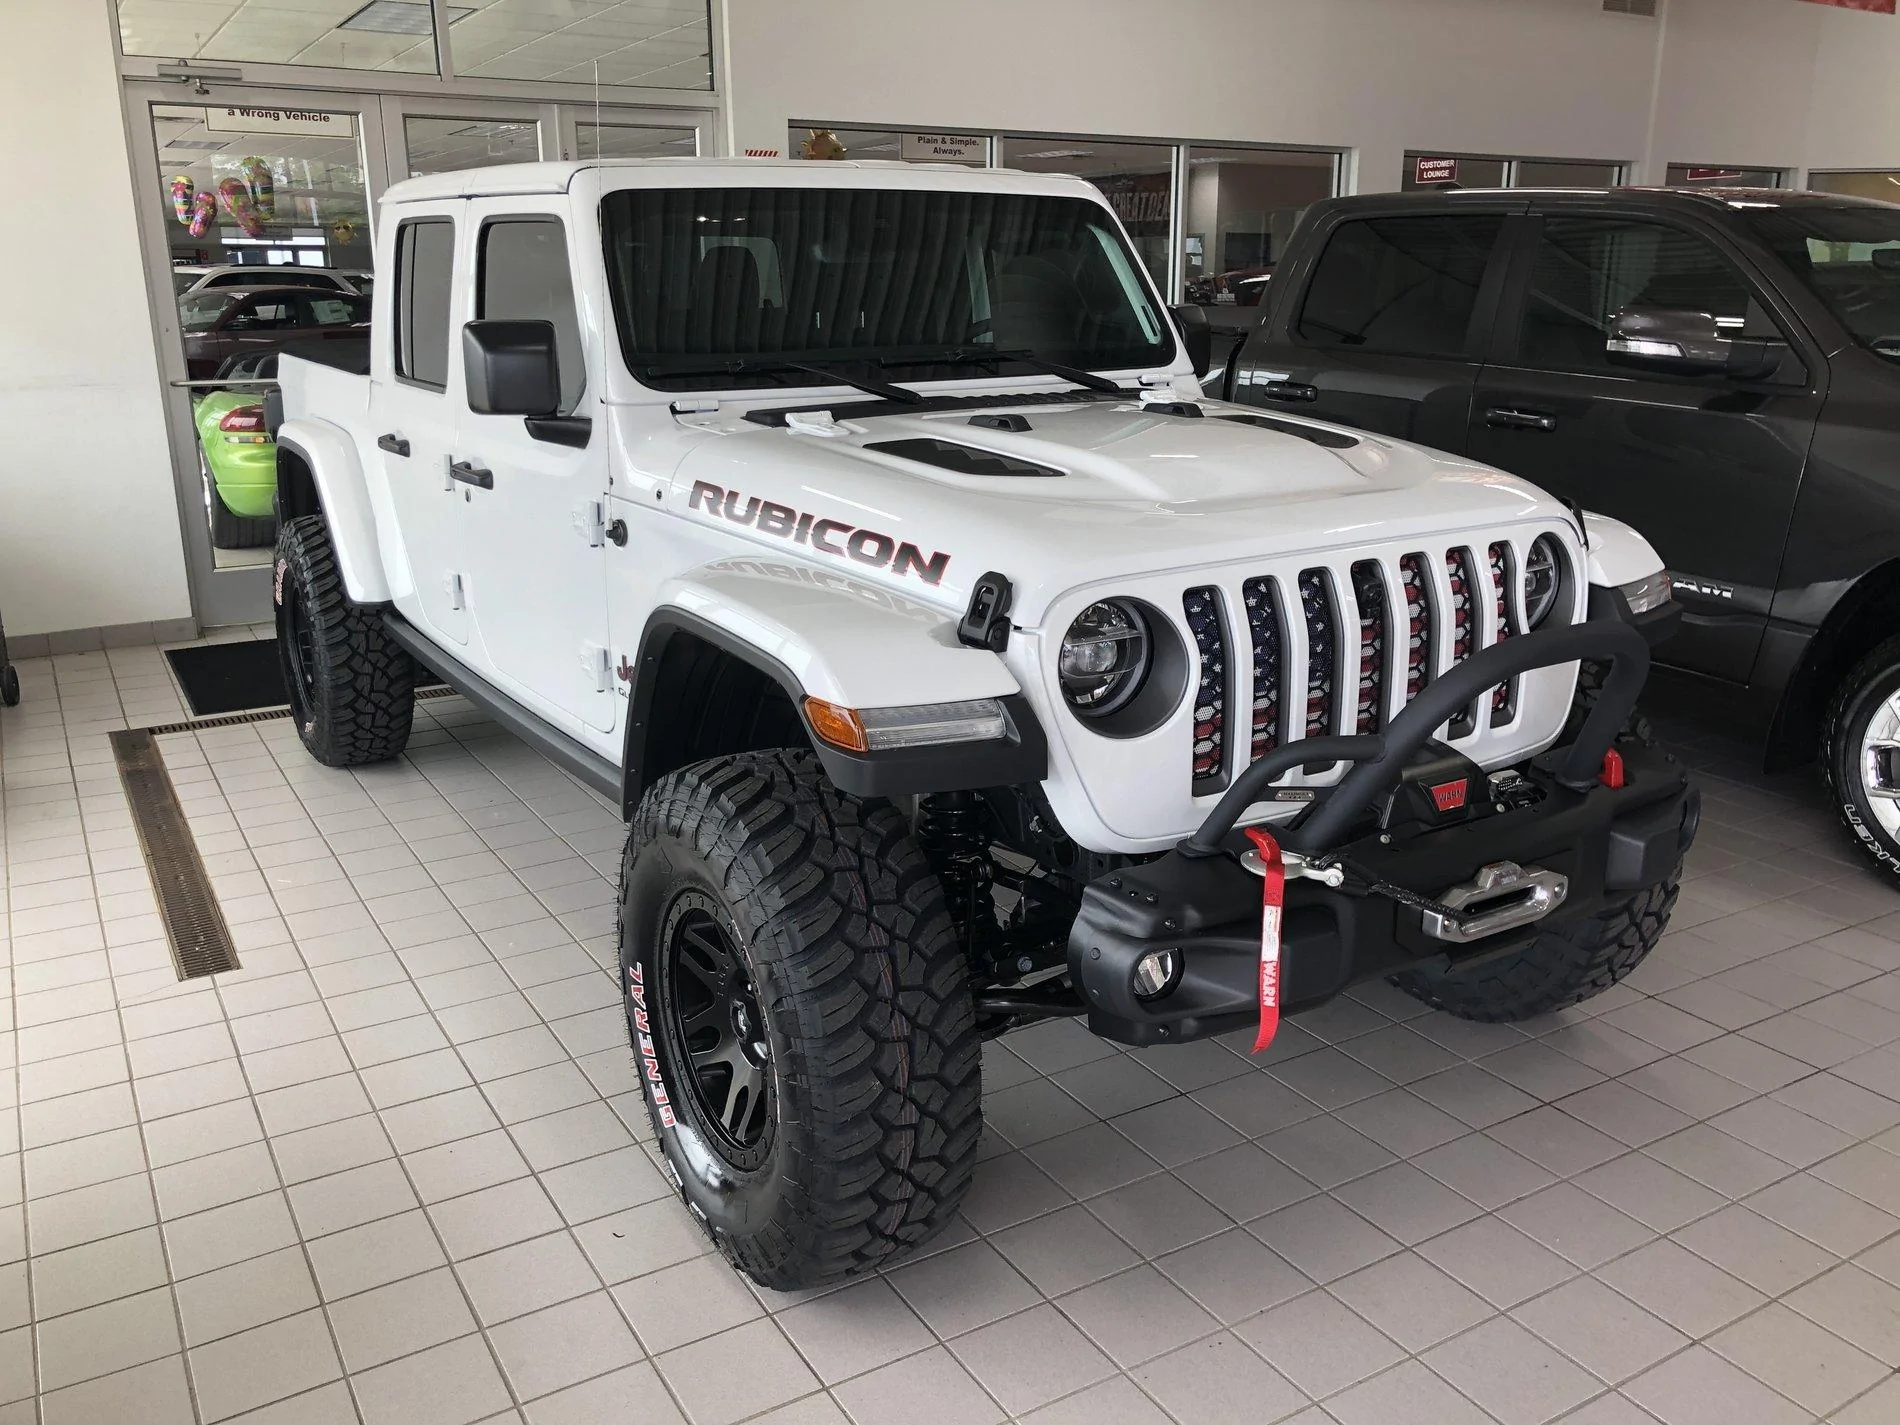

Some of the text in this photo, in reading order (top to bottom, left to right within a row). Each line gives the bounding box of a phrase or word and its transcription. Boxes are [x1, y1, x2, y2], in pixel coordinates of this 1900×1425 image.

[227, 108, 330, 123] a Wrong Vehicle
[917, 136, 980, 148] Plain & Simple.
[933, 147, 965, 156] Always.
[1420, 160, 1454, 169] CUSTOMER
[1424, 170, 1449, 178] LOUNGE
[1147, 190, 1170, 222] DEA
[688, 480, 952, 587] RUBICON
[1673, 578, 1734, 600] AM
[617, 654, 638, 685] Je
[1438, 788, 1462, 802] WARN
[1262, 961, 1277, 1008] WARN
[629, 961, 676, 1128] GENERAL
